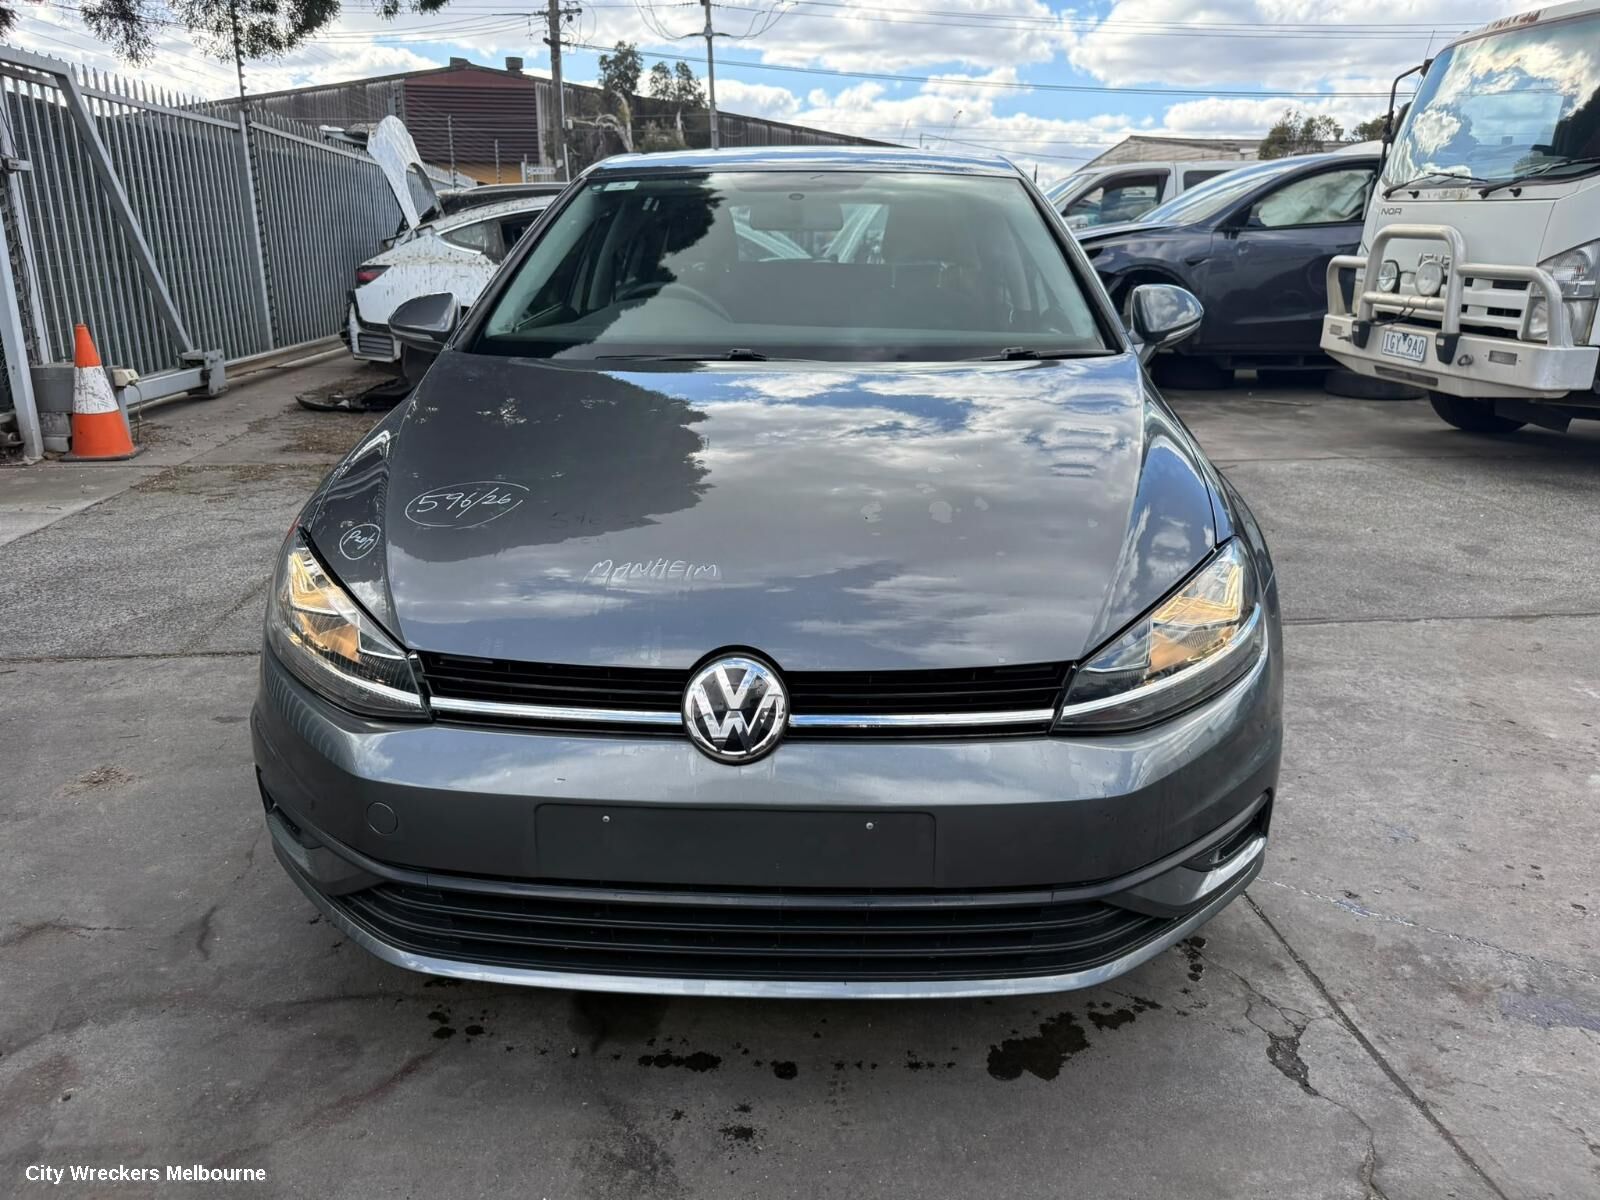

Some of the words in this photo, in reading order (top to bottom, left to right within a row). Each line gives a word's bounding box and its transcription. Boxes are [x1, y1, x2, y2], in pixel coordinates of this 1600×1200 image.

[416, 487, 512, 518] 596/26
[582, 557, 718, 582] MANHEIM
[686, 659, 786, 756] VW
